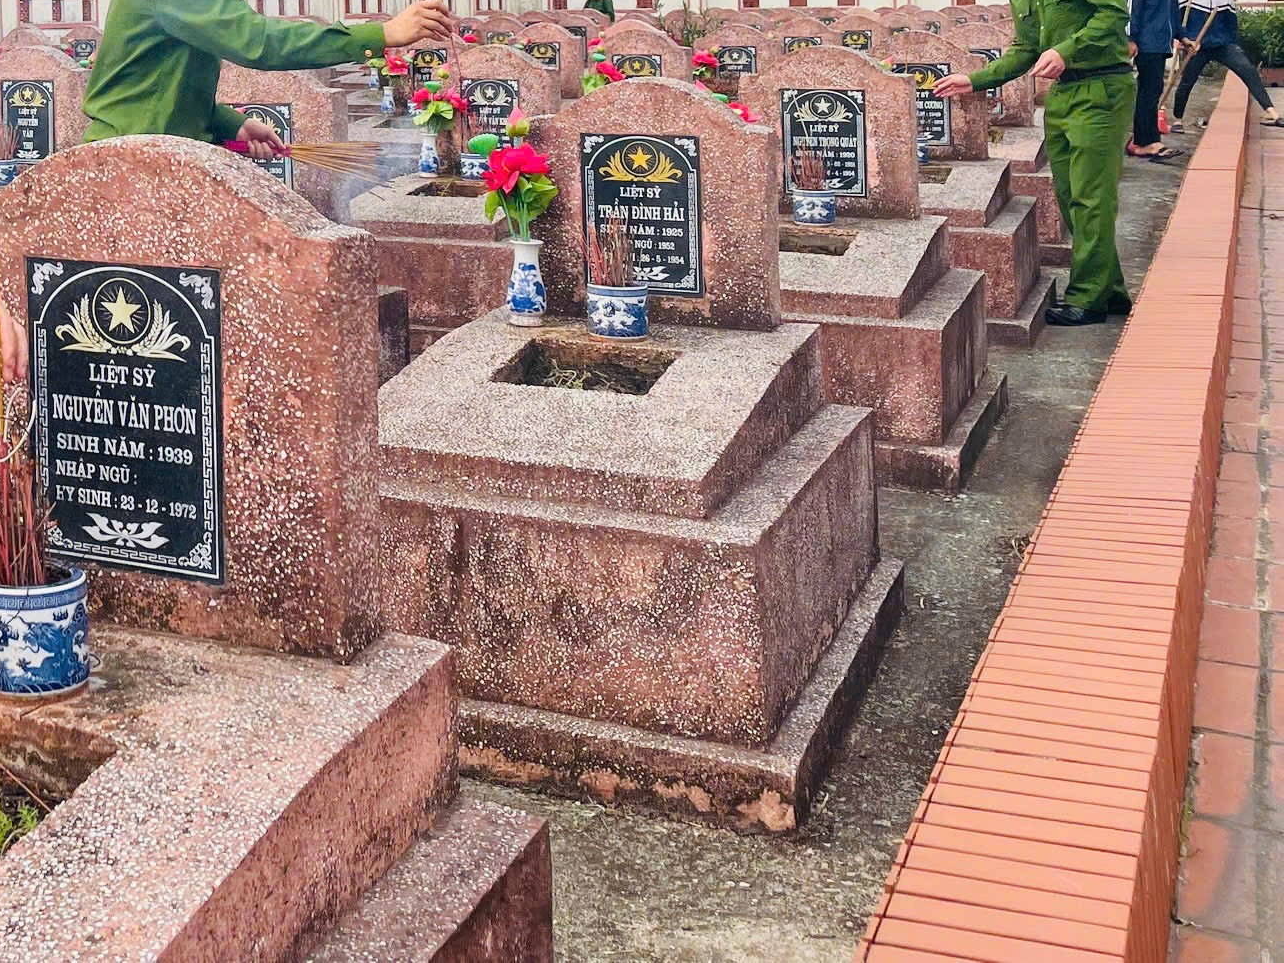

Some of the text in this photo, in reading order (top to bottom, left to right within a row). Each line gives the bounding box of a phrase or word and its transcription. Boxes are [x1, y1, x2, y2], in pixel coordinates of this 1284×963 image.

[619, 184, 645, 200] LIỆT
[598, 197, 685, 222] TRẦN ĐÌNH HẢI
[629, 223, 655, 235] NĂM
[662, 227, 684, 237] 1925
[88, 359, 156, 389] LIỆT SỸ
[52, 384, 197, 436] NGUYỄN VĂN PHƠN
[56, 432, 100, 455] SINH
[103, 435, 146, 460] NĂM
[157, 445, 194, 466] 1939
[55, 457, 96, 482] NHẬP
[99, 463, 130, 485] NGŨ
[55, 484, 76, 502] HY
[77, 486, 112, 508] SINH
[120, 494, 135, 511] 23
[145, 498, 159, 515] 12
[169, 501, 197, 520] 1972
